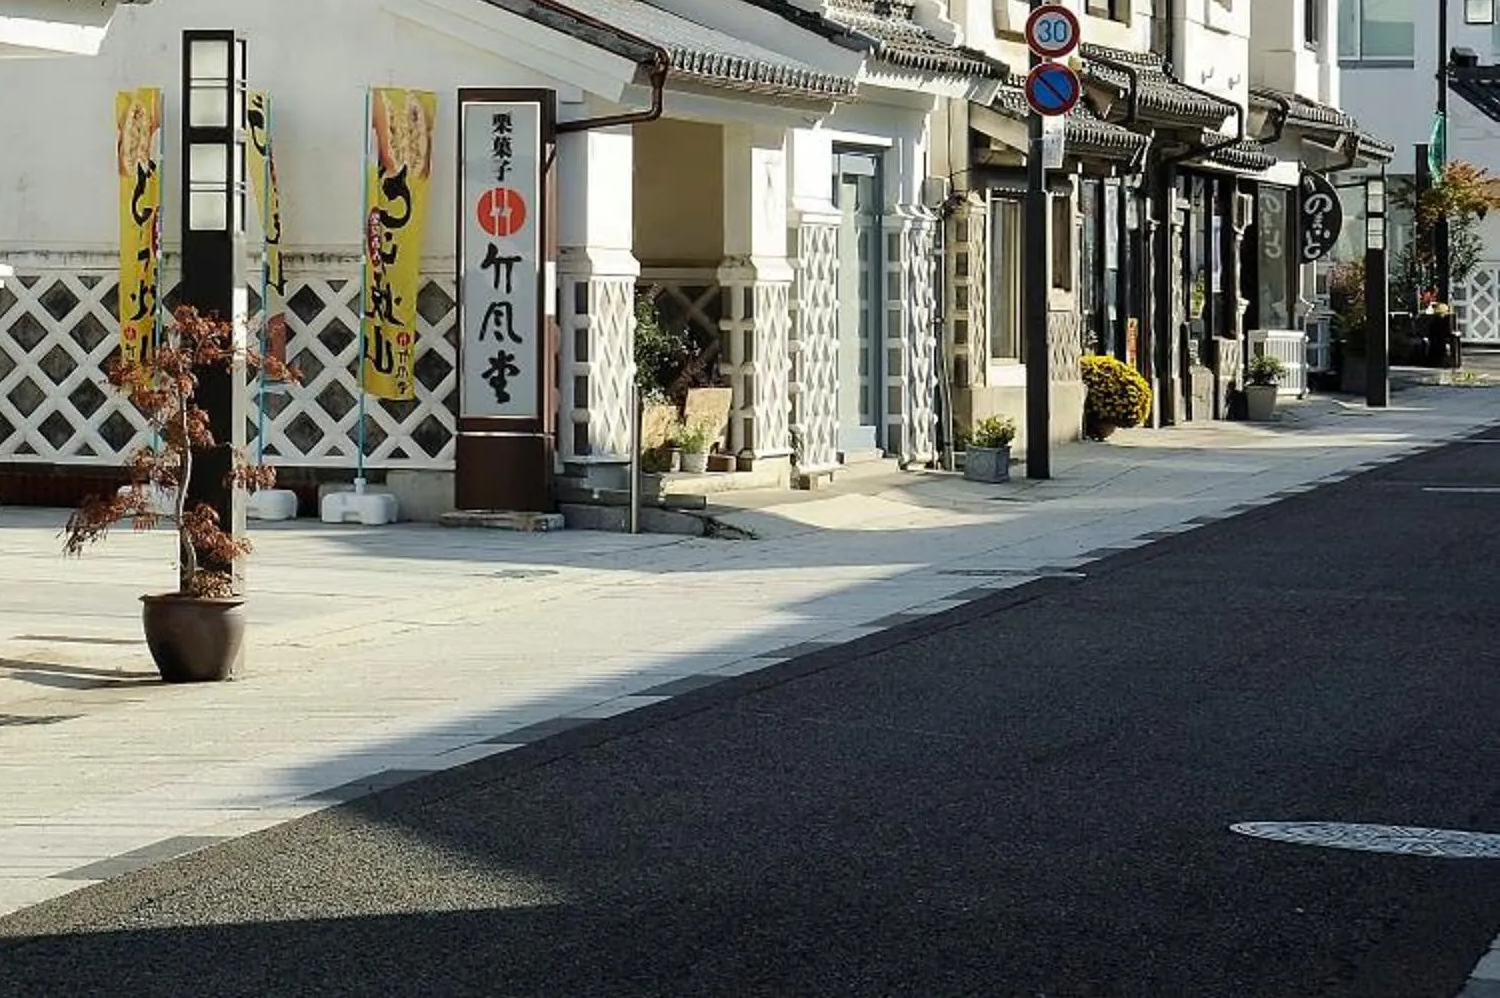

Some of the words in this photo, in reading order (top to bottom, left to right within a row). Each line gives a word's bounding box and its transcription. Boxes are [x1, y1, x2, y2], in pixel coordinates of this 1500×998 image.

[1037, 19, 1068, 43] 30
[491, 112, 513, 181] 栗菓子
[480, 242, 523, 404] 竹風堂
